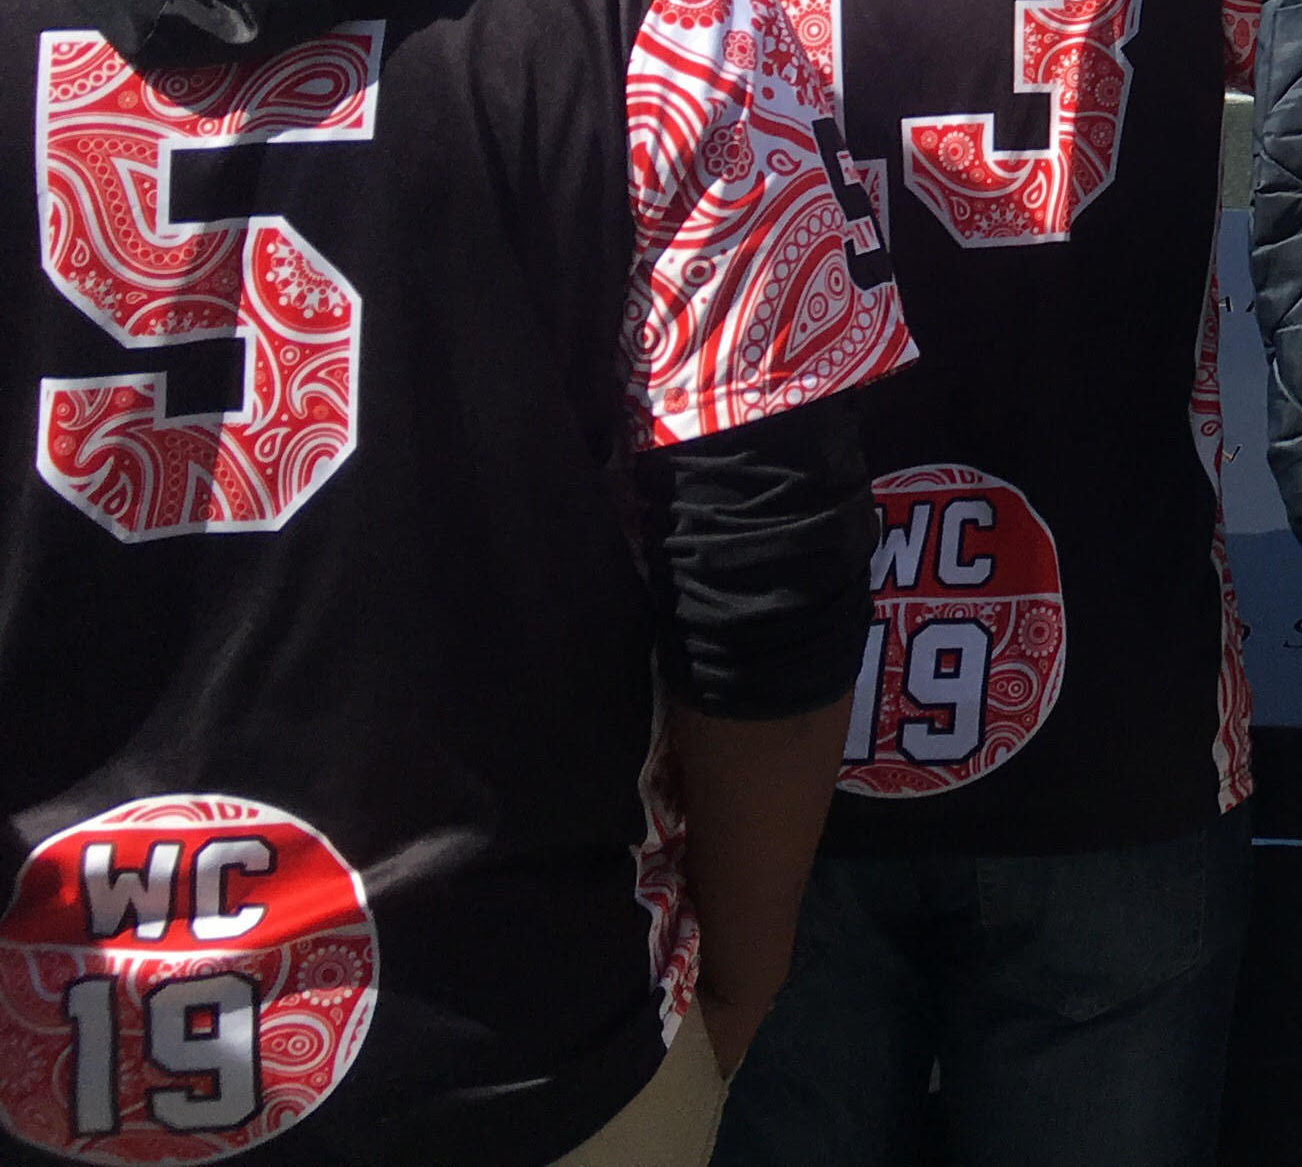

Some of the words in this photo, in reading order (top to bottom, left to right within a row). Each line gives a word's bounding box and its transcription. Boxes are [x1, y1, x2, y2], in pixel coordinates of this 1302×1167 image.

[36, 19, 387, 545] 5
[842, 618, 993, 766] 19
[82, 835, 278, 942] WC
[63, 969, 263, 1135] 19
